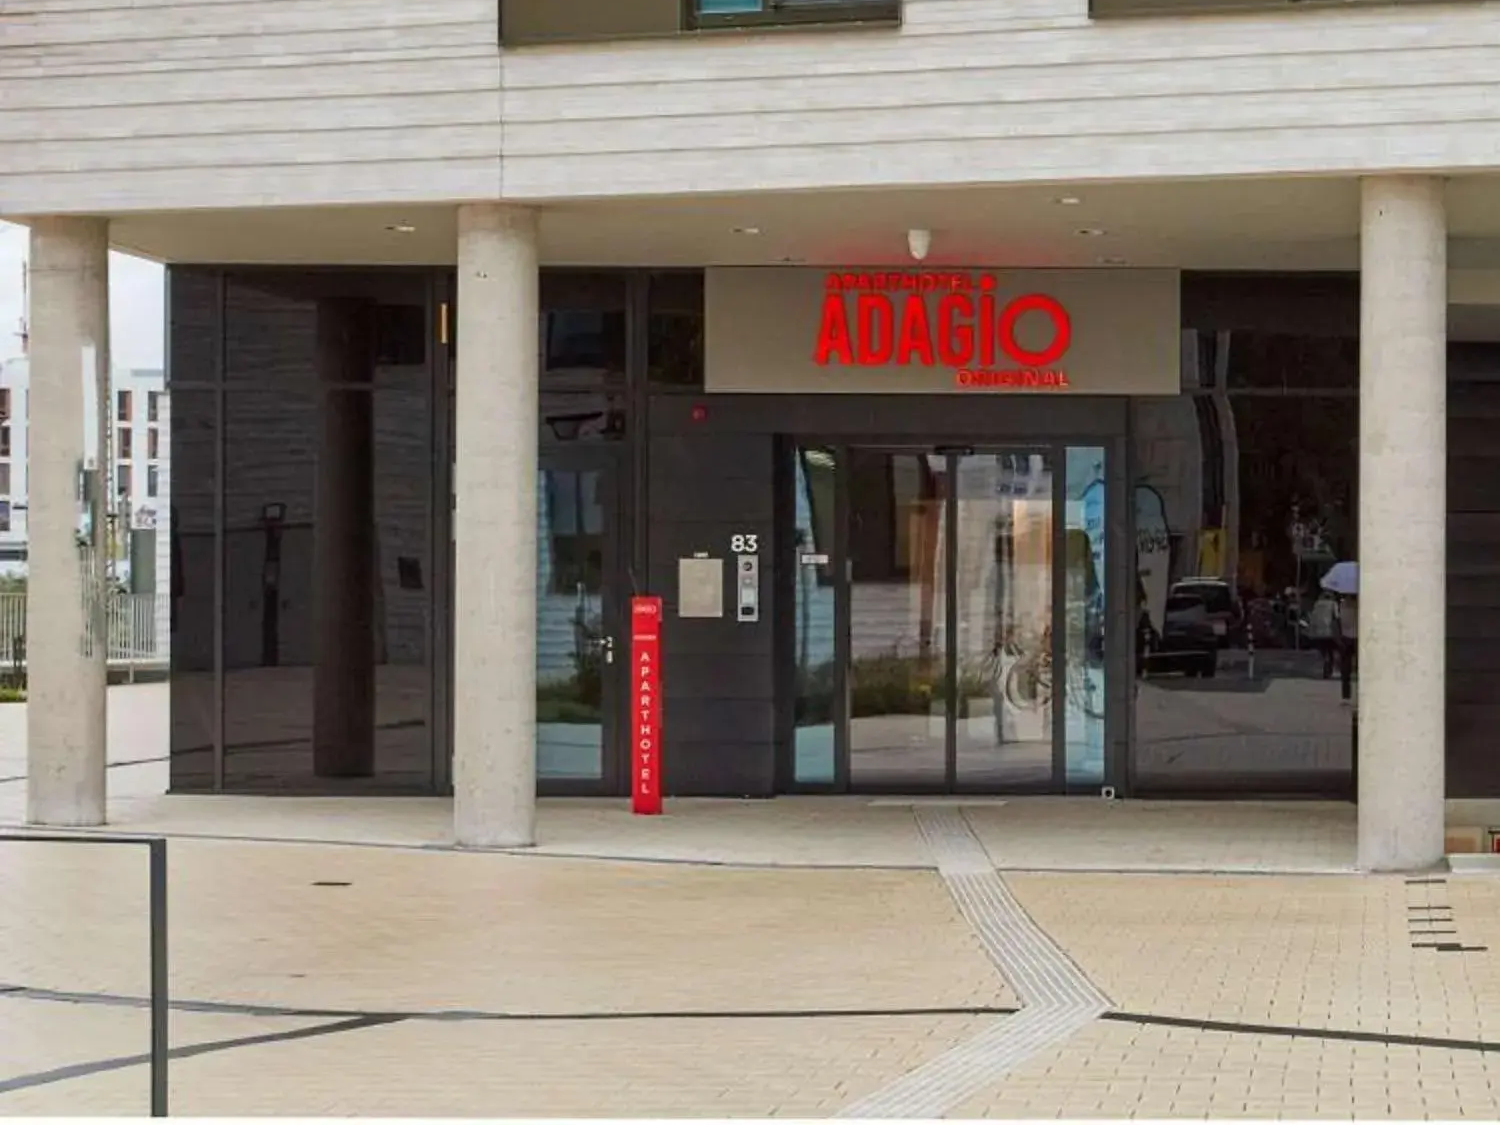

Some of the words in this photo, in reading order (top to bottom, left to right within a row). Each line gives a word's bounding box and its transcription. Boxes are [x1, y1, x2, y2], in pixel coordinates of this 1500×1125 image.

[824, 272, 975, 291] APARTHOTEL
[955, 369, 1070, 386] ORIGINAL
[731, 534, 758, 552] 83
[640, 650, 651, 794] APARTHOTEL
